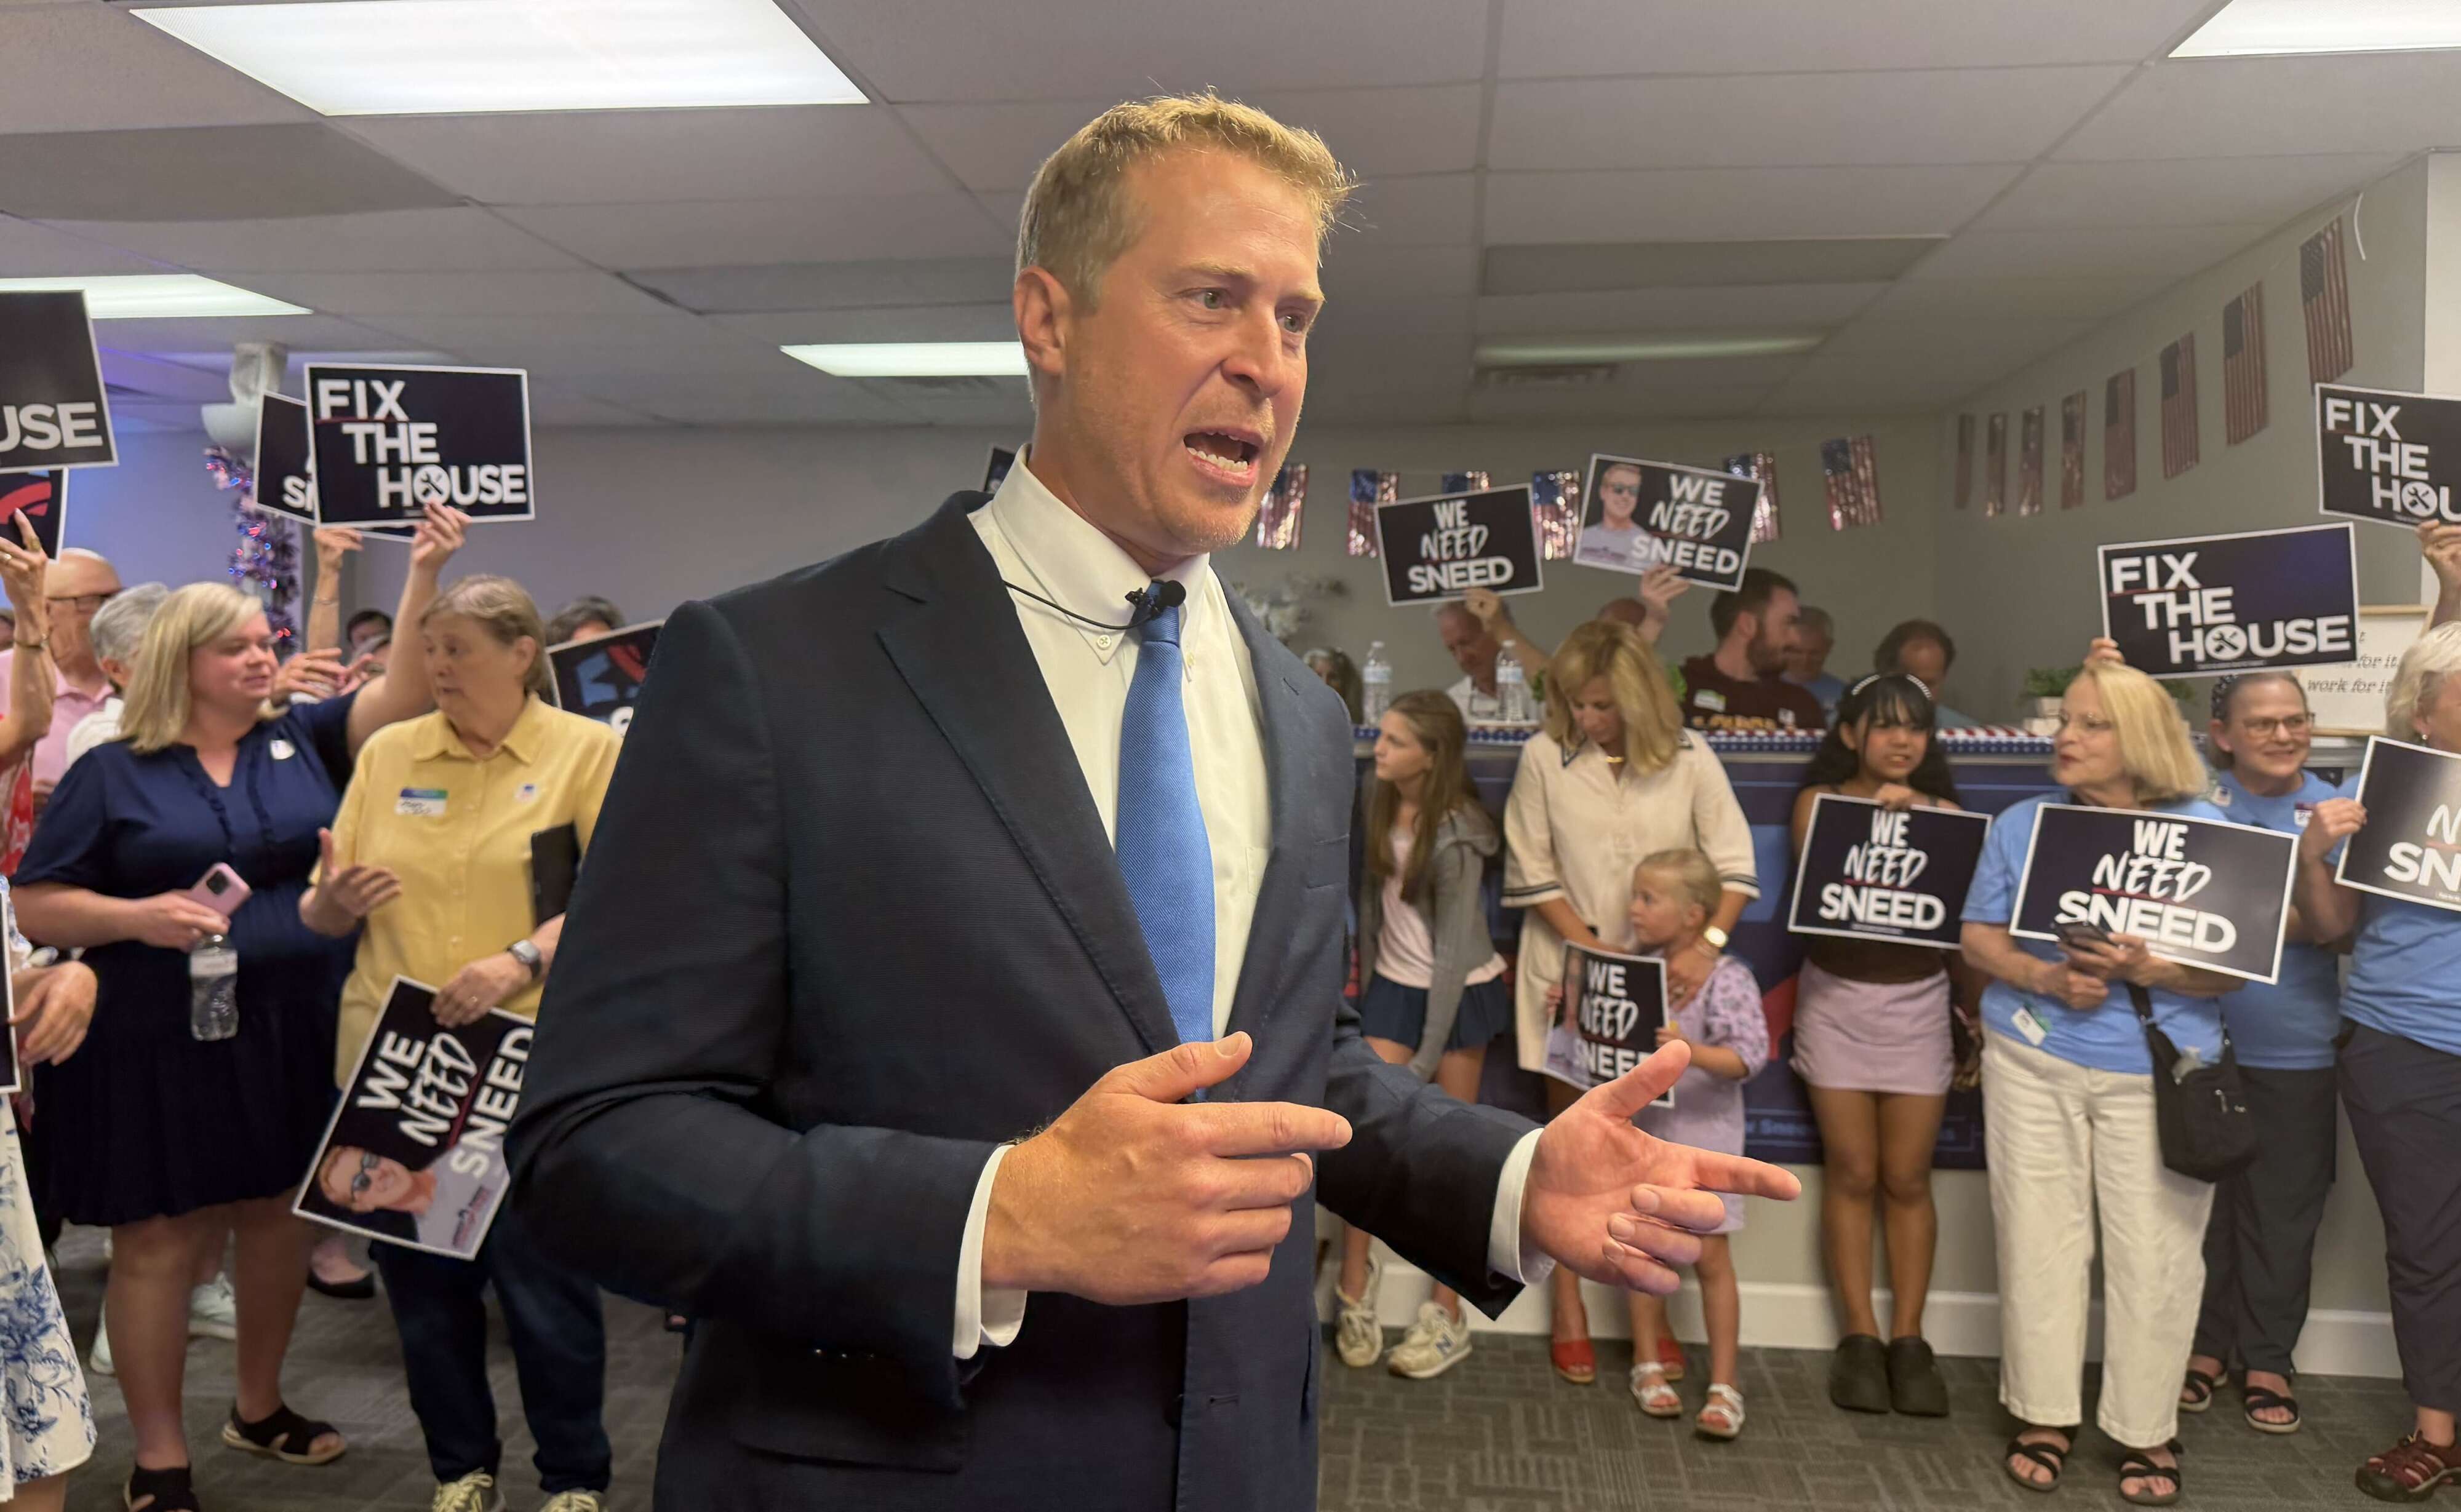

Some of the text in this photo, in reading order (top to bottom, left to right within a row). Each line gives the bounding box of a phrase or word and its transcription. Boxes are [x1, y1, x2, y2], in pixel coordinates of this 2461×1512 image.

[317, 379, 409, 421] FIX
[2326, 397, 2401, 440] FIX
[341, 422, 441, 464] THE
[2343, 435, 2429, 480] THE
[377, 464, 527, 509] HOUSE
[1669, 474, 1726, 506] WE
[1433, 499, 1469, 528] WE
[1649, 499, 1730, 539] NEED
[1421, 525, 1488, 561] NEED
[1631, 534, 1739, 575] SNEED
[1408, 557, 1514, 594] SNEED
[2110, 552, 2200, 594] FIX
[2134, 587, 2235, 630] THE
[2170, 615, 2351, 664] HOUSE
[2308, 678, 2348, 693] work
[2351, 678, 2376, 694] for
[1871, 808, 1911, 847] WE
[2133, 819, 2188, 861] WE
[1845, 841, 1929, 888] NEED
[2092, 850, 2211, 903] NEED
[1819, 883, 1946, 931] SNEED
[2055, 891, 2237, 953] SNEED
[1587, 959, 1627, 997] WE
[1579, 994, 1639, 1041] NEED
[357, 1031, 425, 1108] WE
[399, 1032, 477, 1147] NEED
[450, 1027, 533, 1179] SNEED
